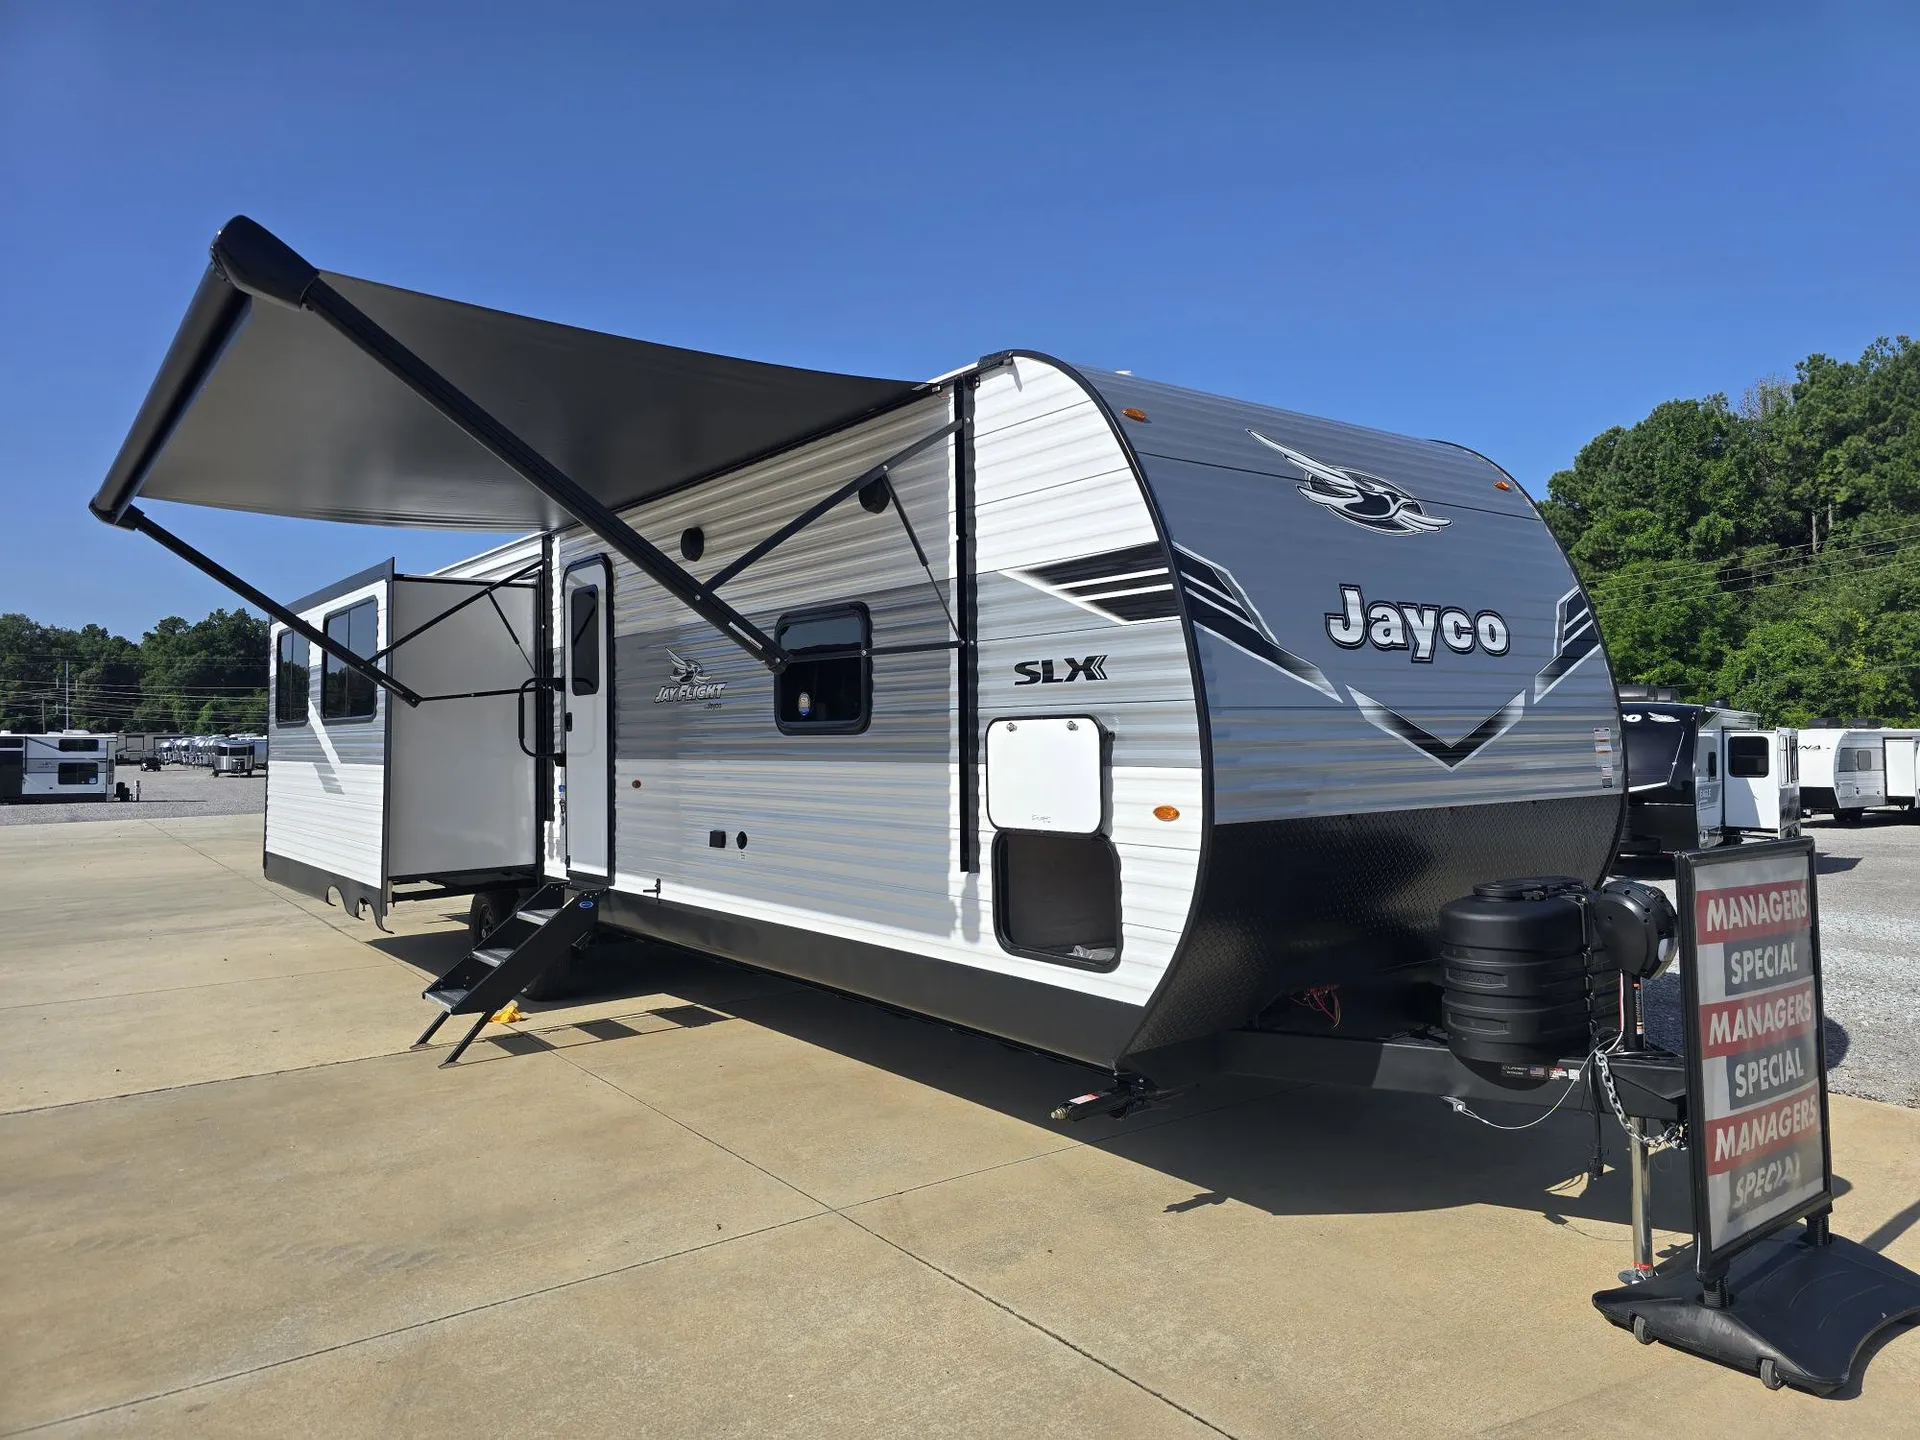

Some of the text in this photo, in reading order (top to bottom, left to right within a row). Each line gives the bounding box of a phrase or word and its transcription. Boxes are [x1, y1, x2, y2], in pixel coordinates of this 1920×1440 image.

[1325, 584, 1510, 663] Jayco
[654, 682, 728, 703] JAY FLIGHT
[1014, 655, 1108, 686] SLX
[1706, 888, 1807, 932] MANAGERS
[1730, 942, 1798, 985] SPECIAL
[1708, 990, 1812, 1046] MANAGERS
[1735, 1047, 1804, 1098] SPECIAL
[1714, 1094, 1817, 1162] MANAGERS
[1732, 1152, 1800, 1209] SPECIAL
